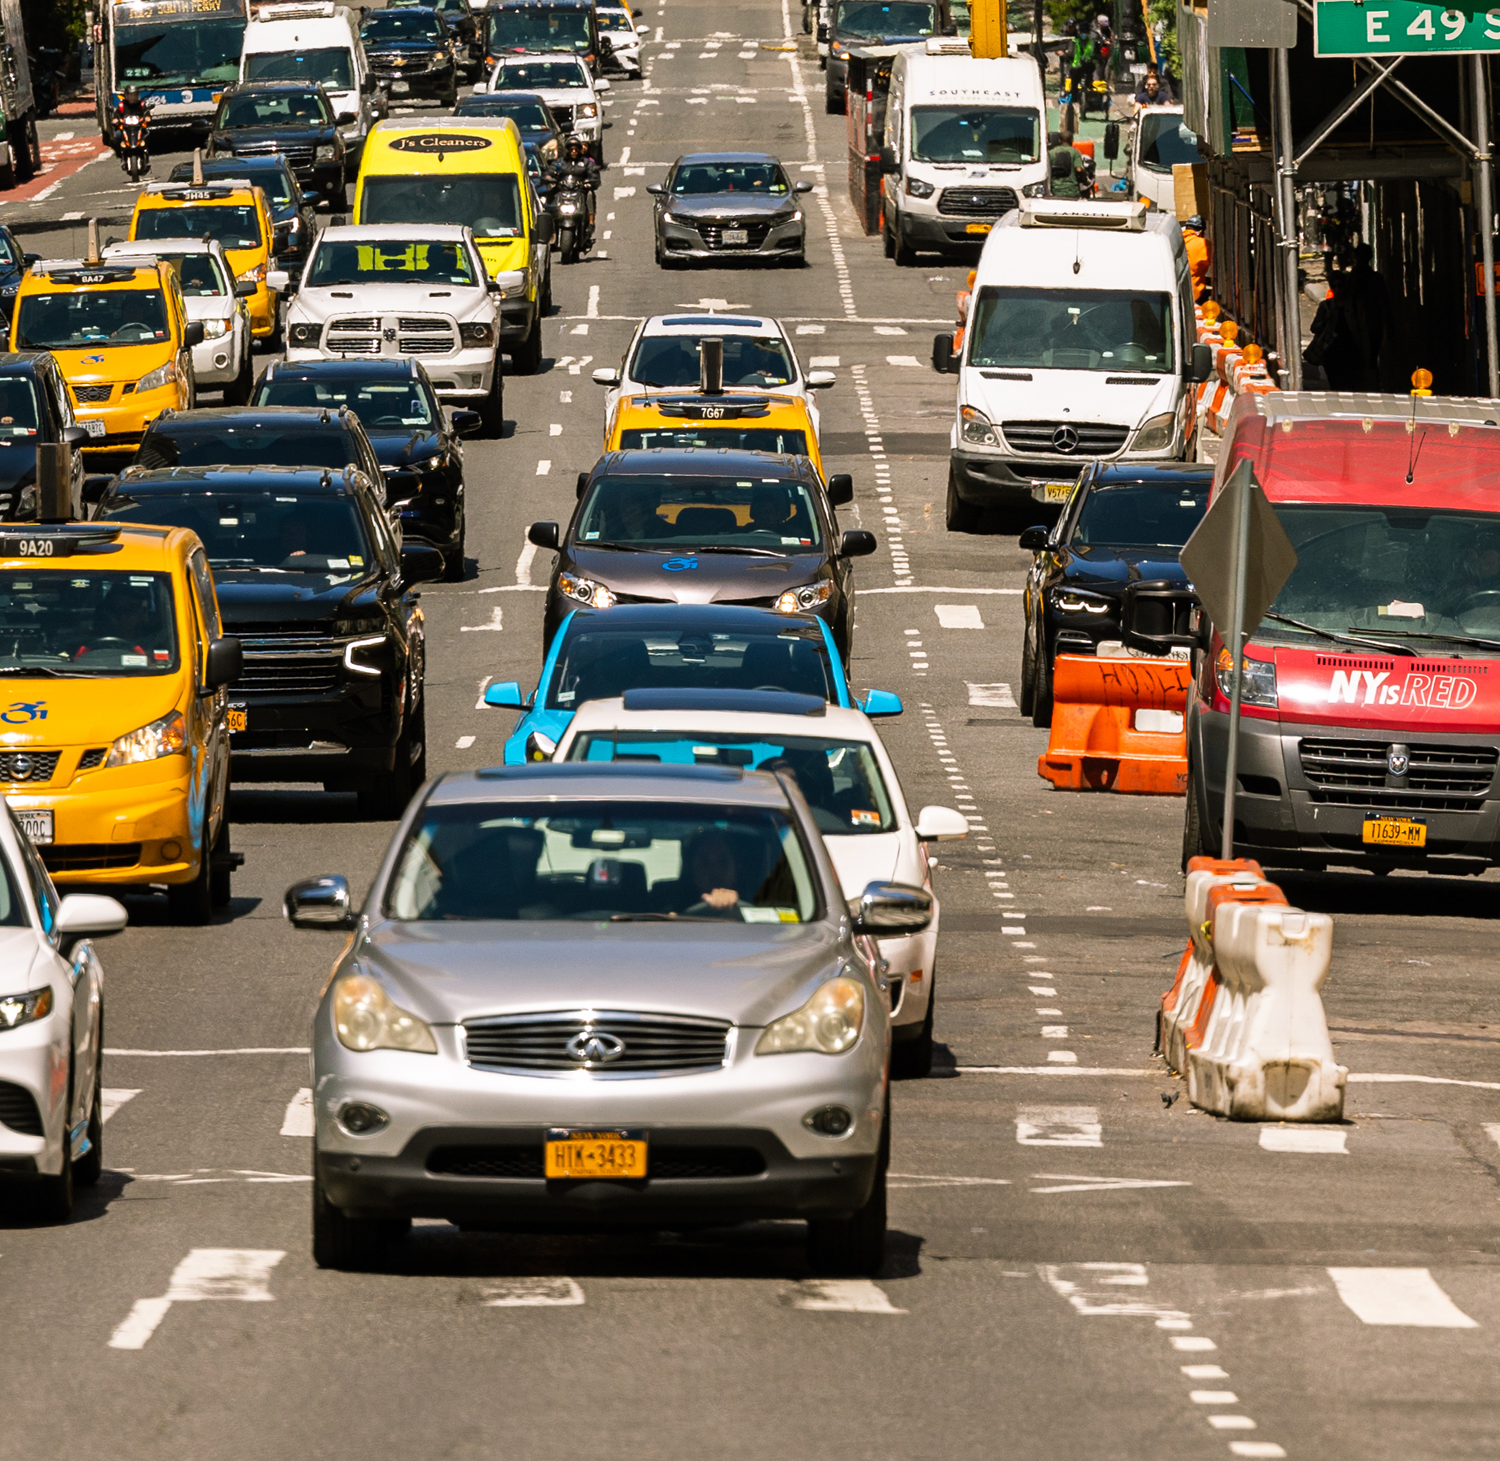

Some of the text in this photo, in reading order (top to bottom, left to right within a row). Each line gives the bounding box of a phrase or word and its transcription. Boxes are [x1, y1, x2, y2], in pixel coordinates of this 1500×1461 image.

[1366, 11, 1391, 43] E
[1406, 9, 1466, 41] 49
[929, 89, 1021, 98] SOUTHEAST
[399, 137, 486, 150] J's Cleaners
[701, 407, 725, 419] 7G67
[19, 540, 54, 556] 9A20
